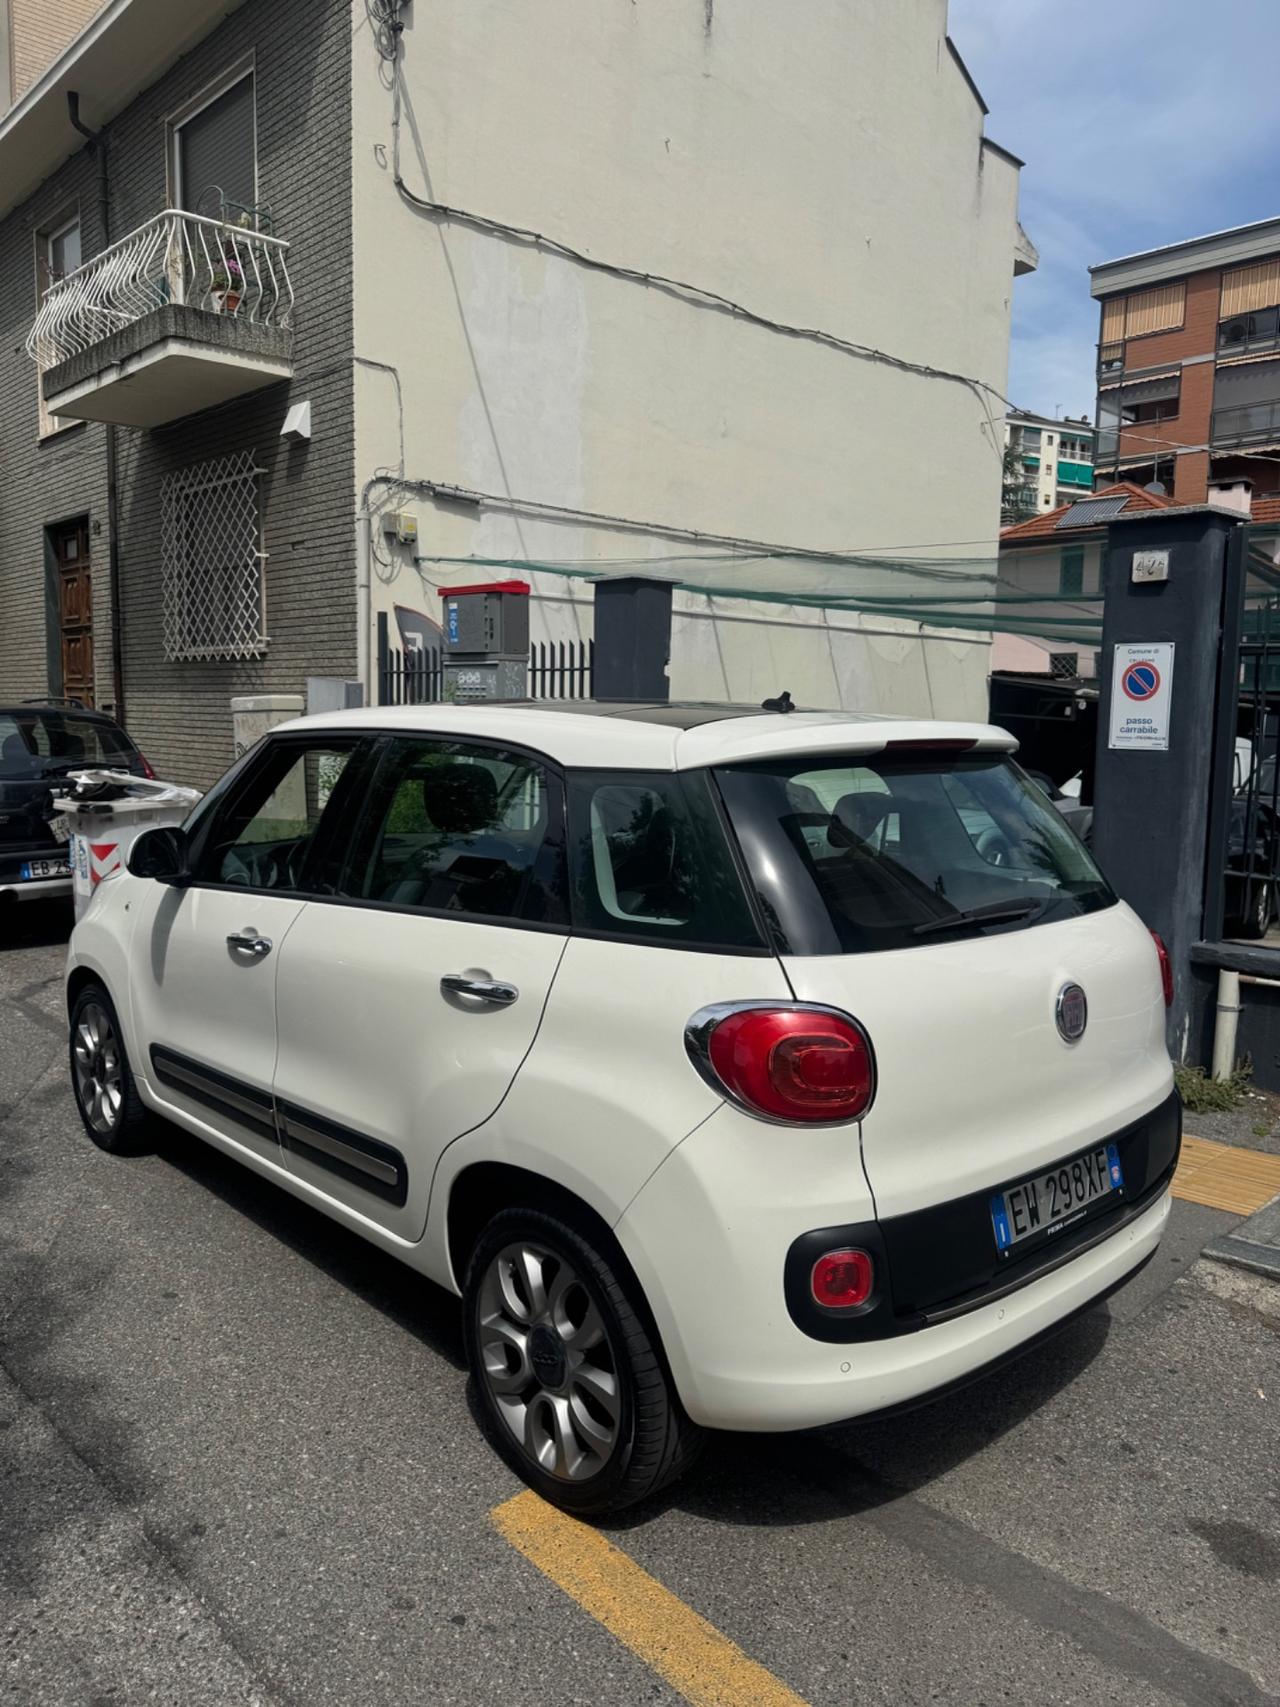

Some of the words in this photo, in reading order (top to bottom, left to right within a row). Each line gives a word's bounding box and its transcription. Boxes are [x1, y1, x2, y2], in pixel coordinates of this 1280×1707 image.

[1126, 718, 1153, 726] passo
[1119, 726, 1159, 734] carrabile
[31, 860, 50, 877] EB
[1009, 1183, 1040, 1236] EW
[1046, 1150, 1107, 1218] 298XF
